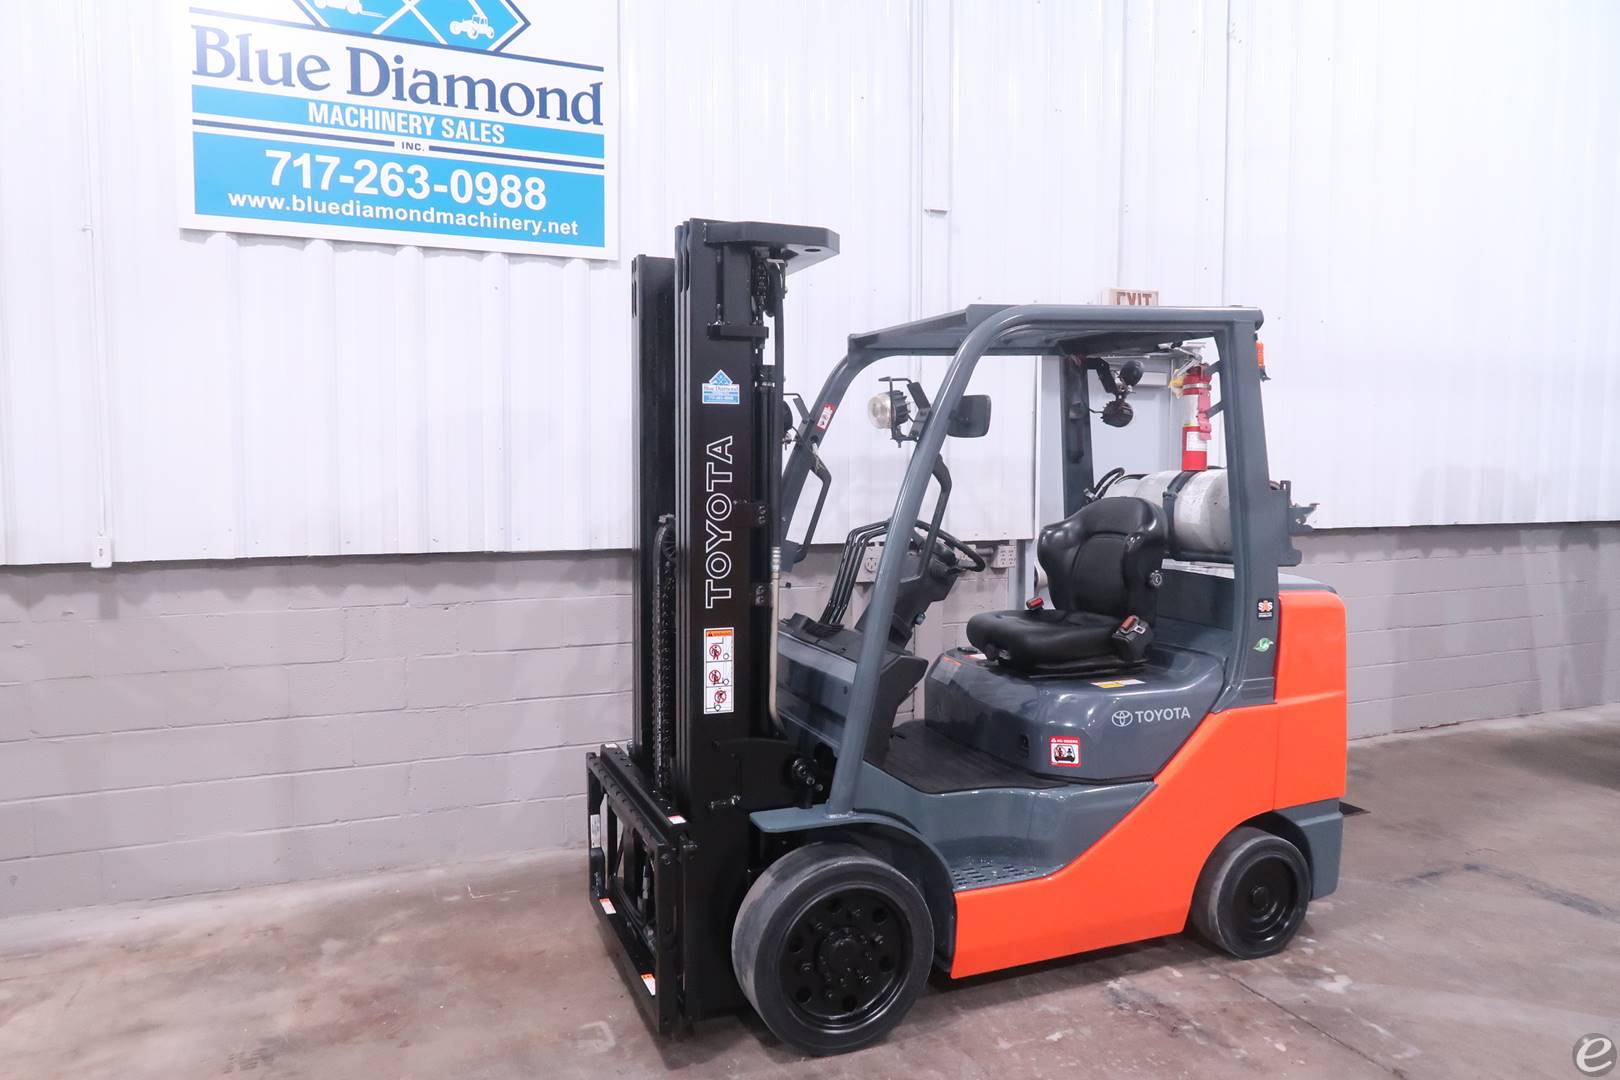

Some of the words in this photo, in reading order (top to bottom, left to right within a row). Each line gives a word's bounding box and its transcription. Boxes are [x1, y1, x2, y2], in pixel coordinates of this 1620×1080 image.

[191, 23, 331, 91] Blue
[346, 46, 604, 126] Diamond
[307, 102, 435, 137] MACHINERY
[441, 117, 506, 145] SALES
[400, 140, 425, 152] INC.
[264, 148, 547, 211] 717-263-0988
[227, 191, 579, 236] www.bluediamondmachinery.net
[705, 435, 733, 609] TOYOTA
[1135, 706, 1191, 723] TOYOTA
